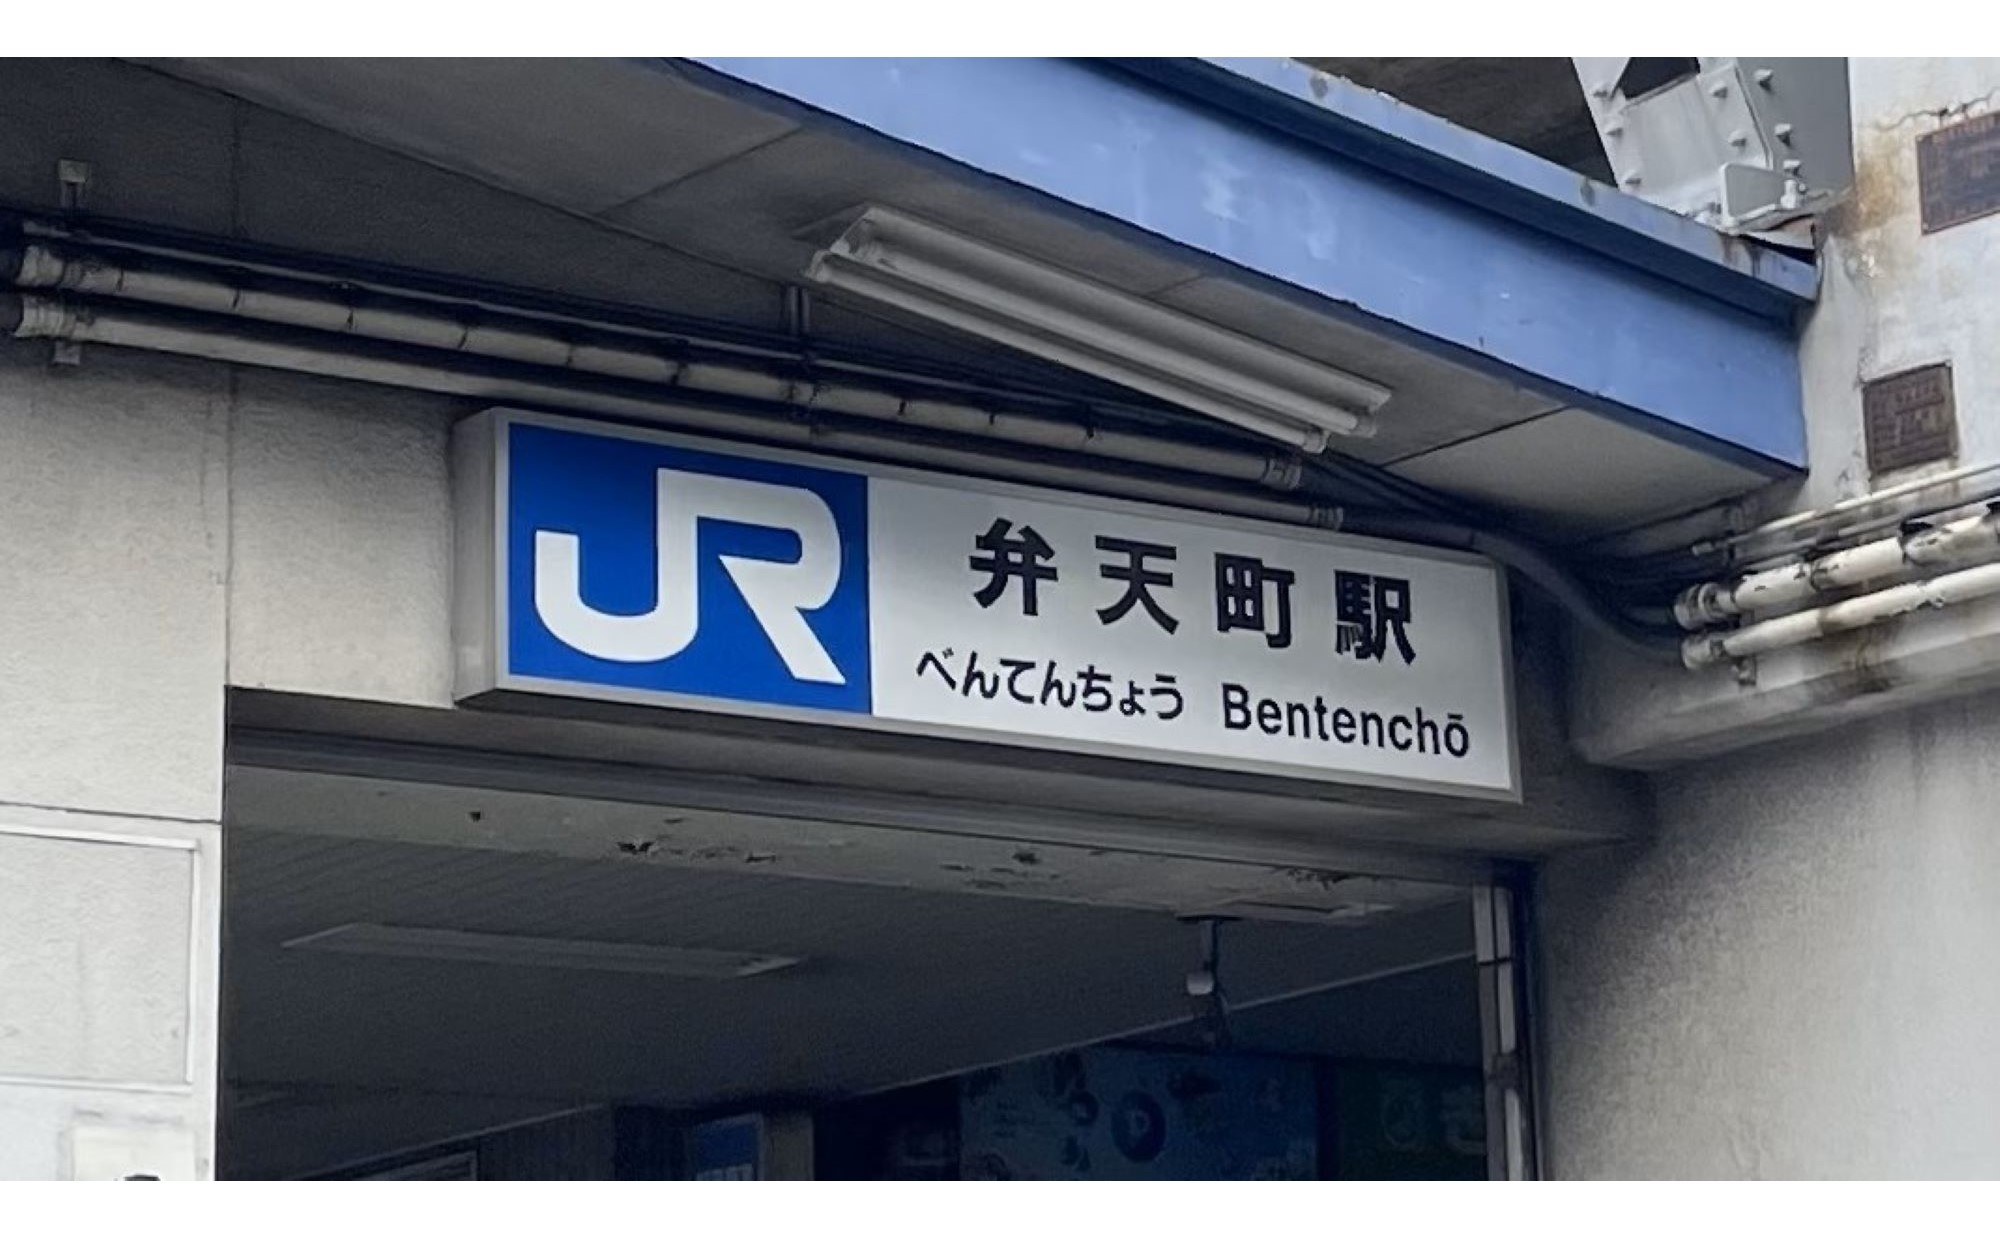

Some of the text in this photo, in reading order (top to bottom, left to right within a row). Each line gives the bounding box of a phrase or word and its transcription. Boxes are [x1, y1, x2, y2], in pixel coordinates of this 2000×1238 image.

[535, 467, 847, 685] JR
[968, 517, 1417, 666] 弁天町駅
[917, 648, 1184, 720] べんてんちょう
[1223, 683, 1470, 758] Bentenchō
